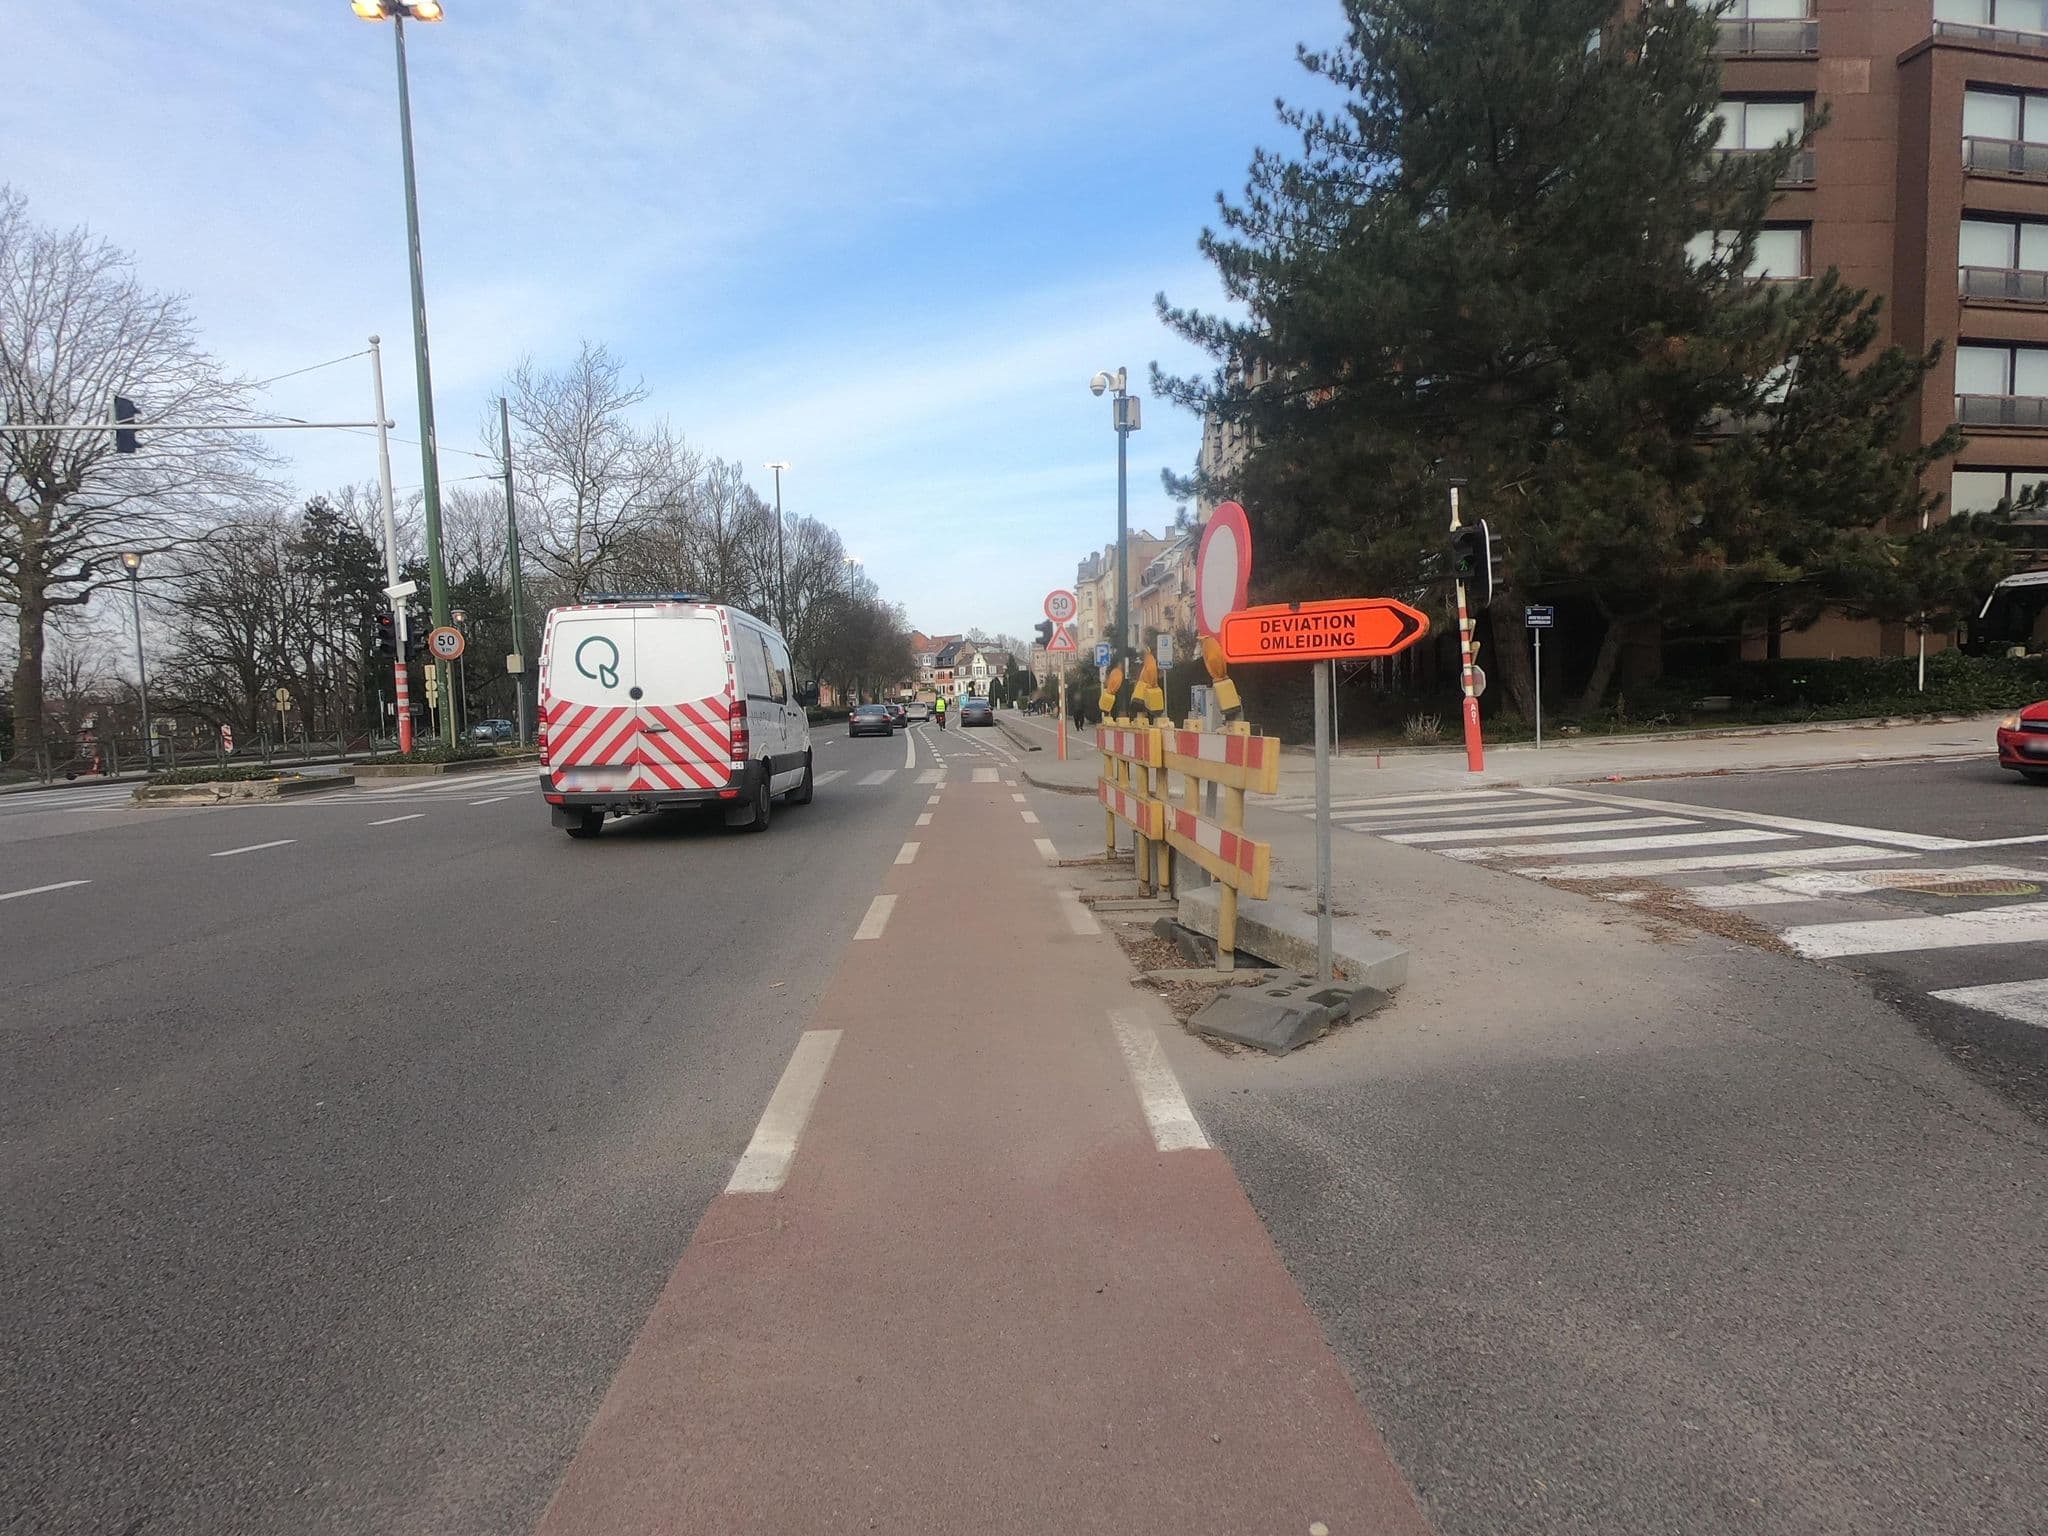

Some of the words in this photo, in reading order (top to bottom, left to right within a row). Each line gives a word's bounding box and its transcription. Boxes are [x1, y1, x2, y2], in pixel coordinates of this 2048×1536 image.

[1052, 597, 1068, 610] 50
[1260, 614, 1356, 634] DEVIATION
[438, 635, 455, 646] 50
[1260, 632, 1356, 650] OMLEIDING
